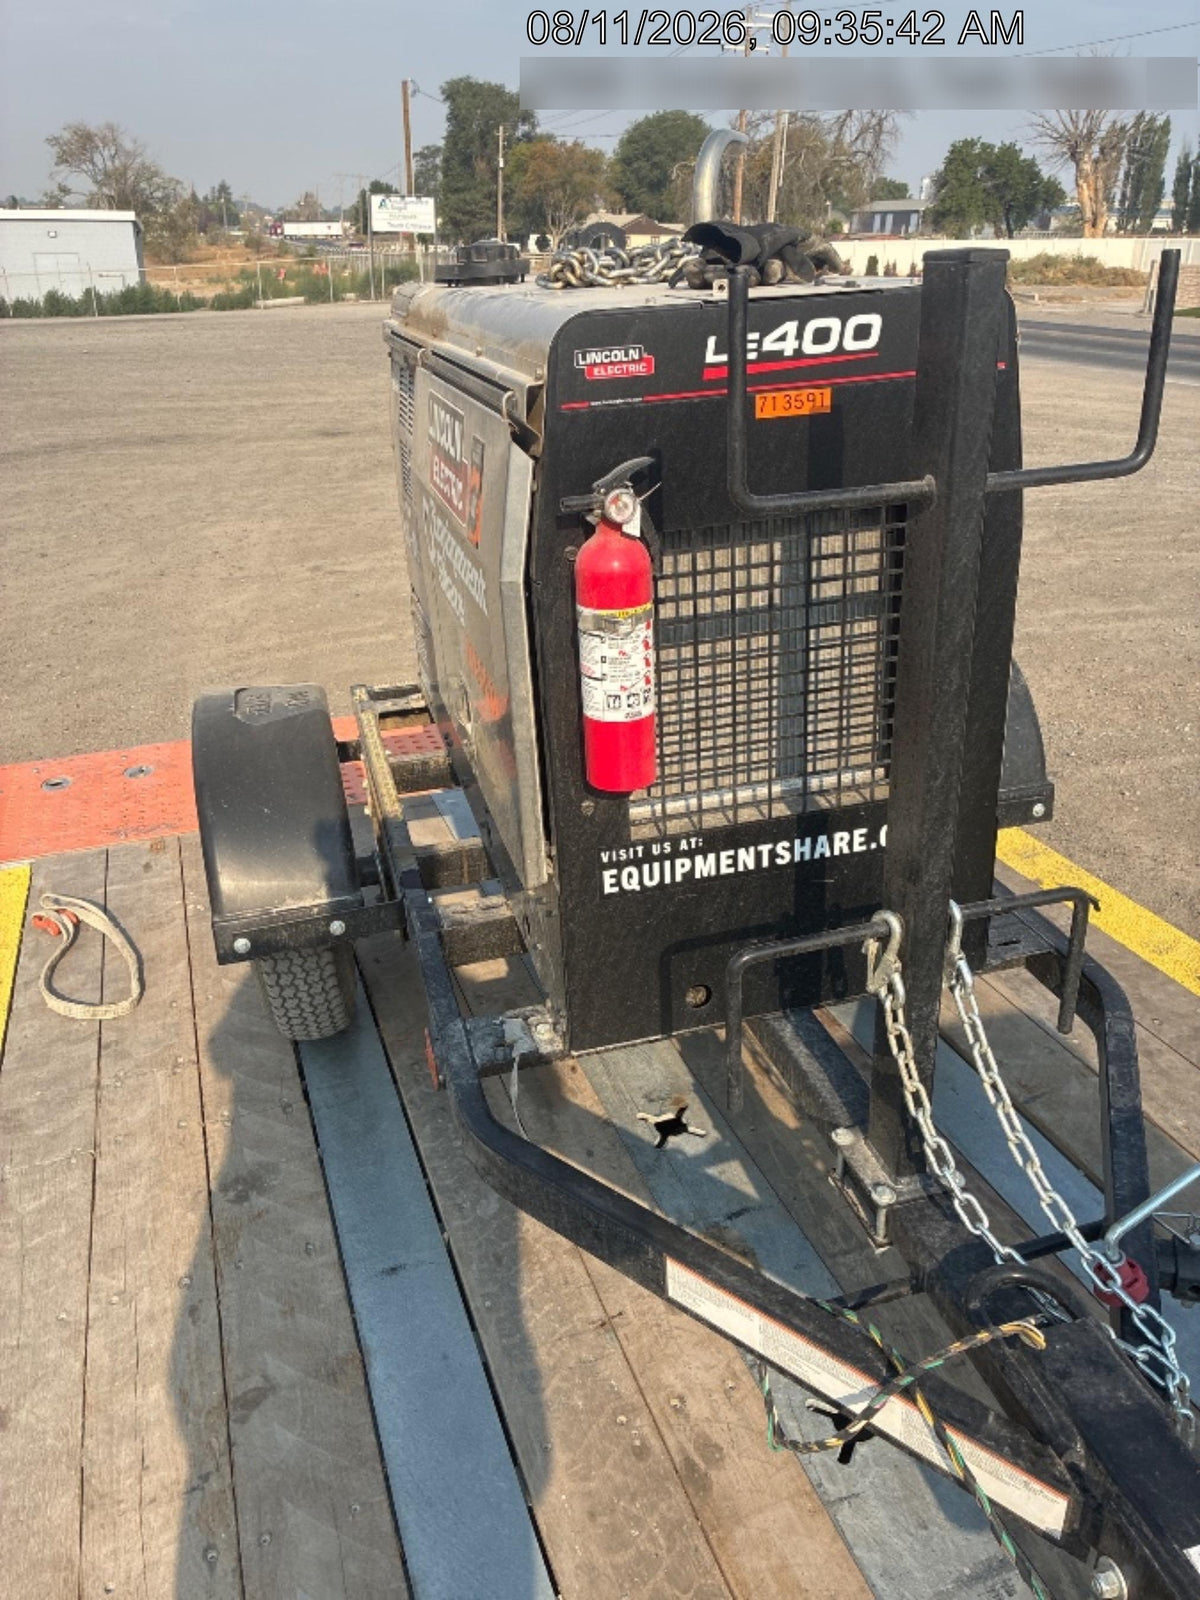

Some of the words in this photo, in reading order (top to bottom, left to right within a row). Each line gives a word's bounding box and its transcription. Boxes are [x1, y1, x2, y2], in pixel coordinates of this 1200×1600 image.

[705, 313, 882, 363] LE400
[578, 348, 639, 365] LINCOLN
[593, 362, 648, 376] ELECTRIC
[759, 392, 826, 414] 713591
[601, 845, 644, 863] VISIT
[652, 842, 671, 856] US
[679, 837, 703, 851] AT:
